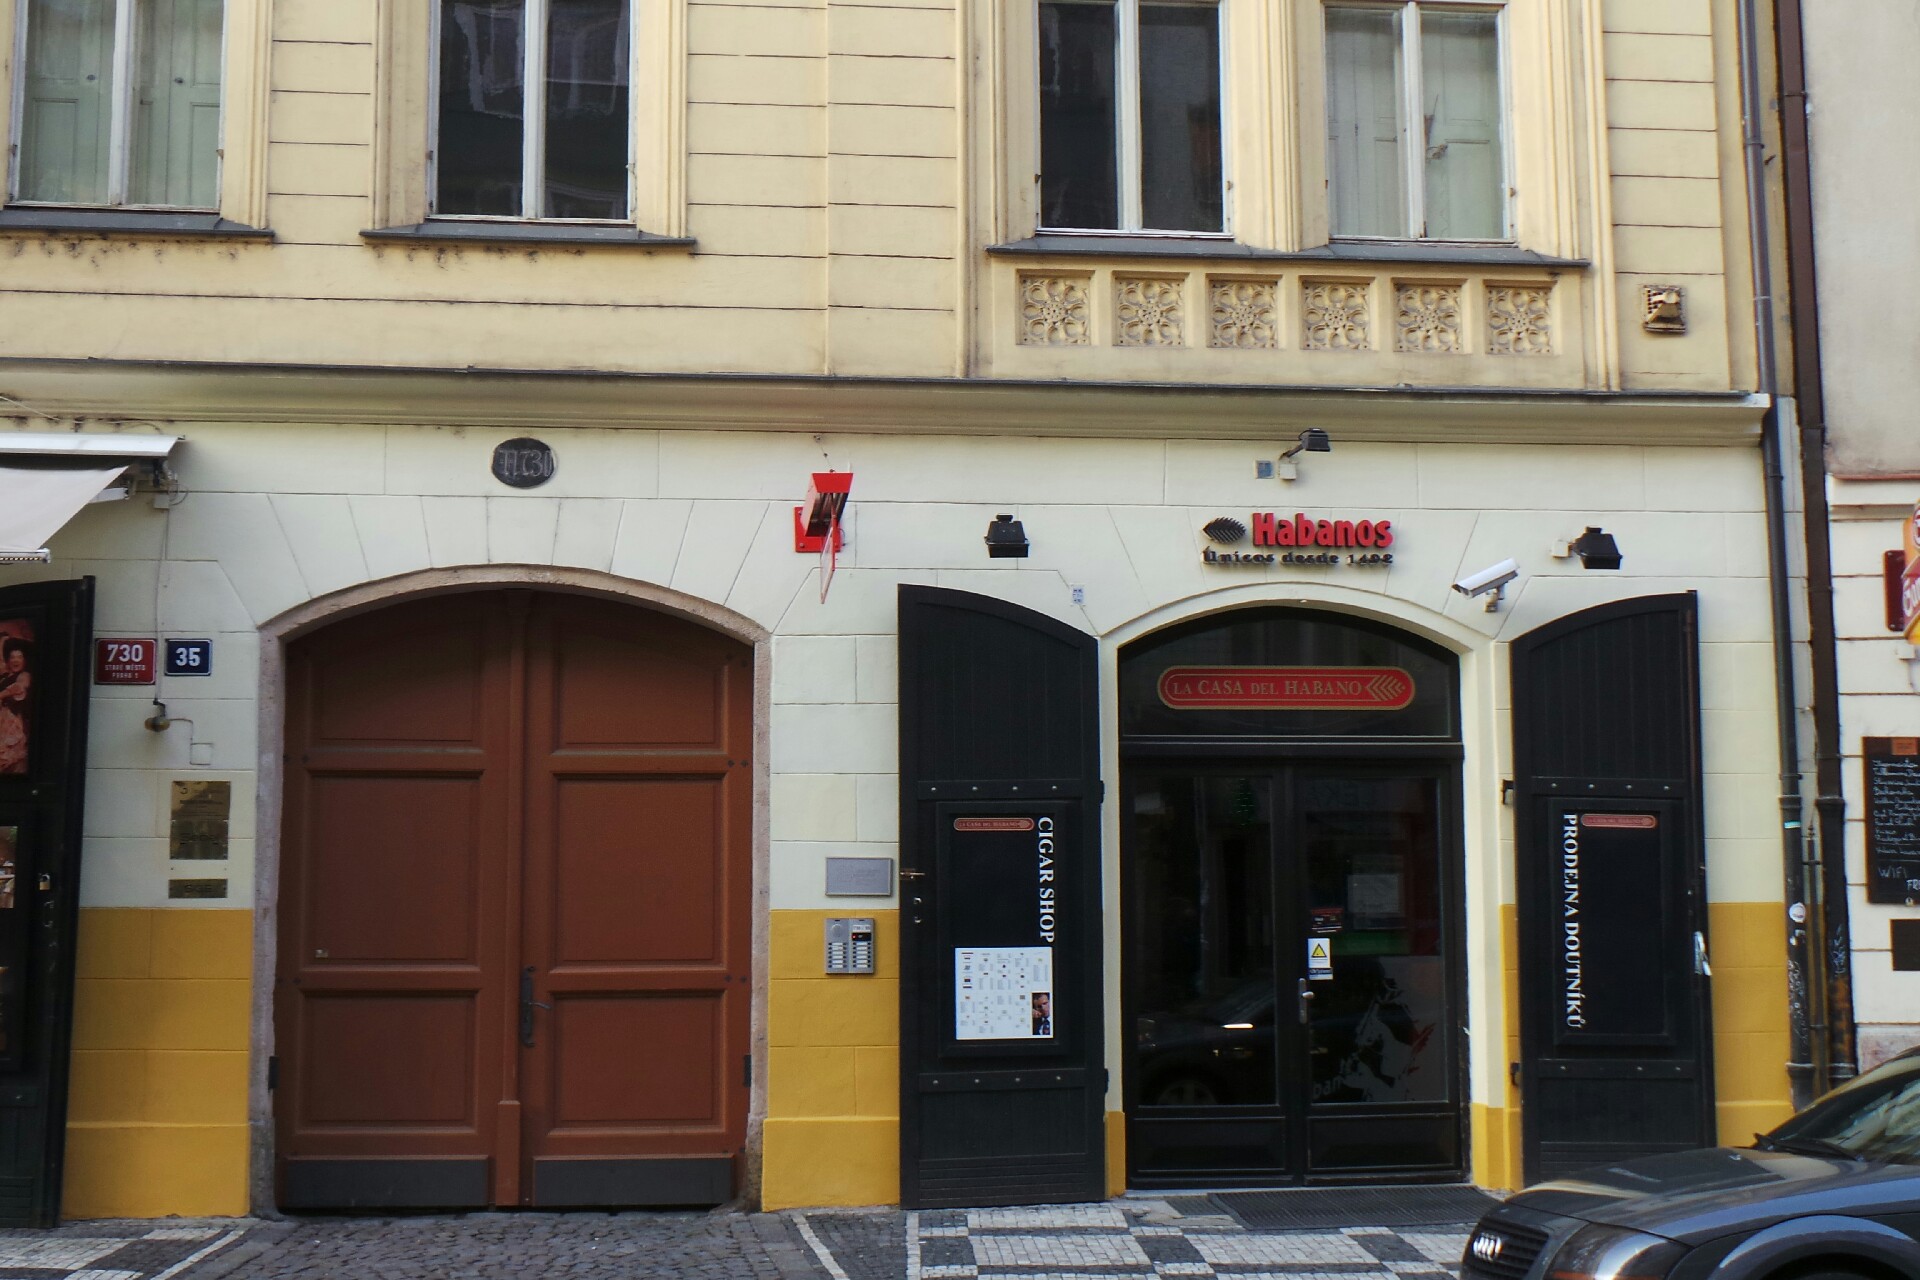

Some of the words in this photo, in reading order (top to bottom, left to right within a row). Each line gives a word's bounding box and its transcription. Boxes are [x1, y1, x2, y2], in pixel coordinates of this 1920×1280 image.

[1252, 512, 1394, 548] Habanos
[1202, 546, 1276, 564] Únicos
[1280, 552, 1340, 564] desde
[107, 644, 143, 662] 730
[175, 647, 201, 667] 35
[1173, 682, 1192, 695] LA
[1197, 680, 1244, 695] CASA
[1250, 682, 1279, 695] DEL
[1284, 681, 1362, 696] HABANO
[1038, 816, 1054, 884] CIGAR
[1563, 814, 1580, 917] PRODEJNA
[1039, 887, 1055, 943] SHOP
[1564, 922, 1586, 1029] DOUTNÍKŮ
